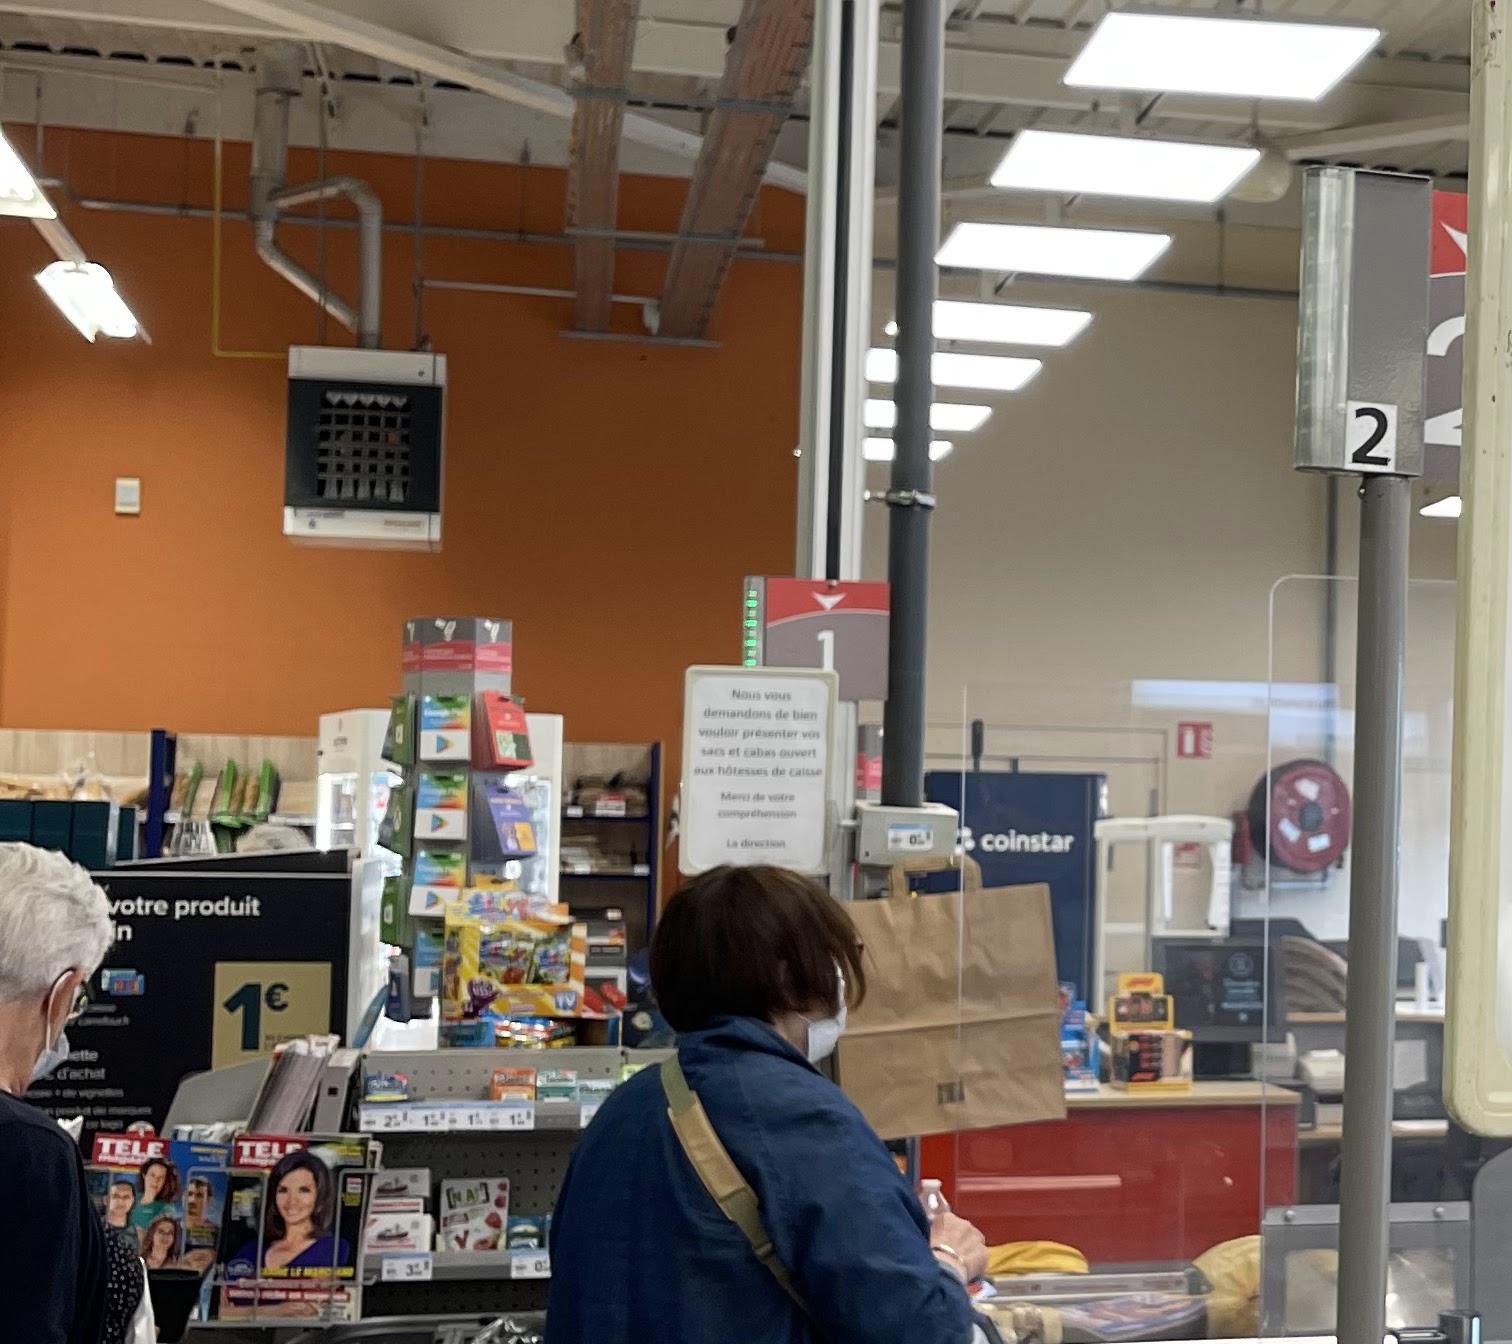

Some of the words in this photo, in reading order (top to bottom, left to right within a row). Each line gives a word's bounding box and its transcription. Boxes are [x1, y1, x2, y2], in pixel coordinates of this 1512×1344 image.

[1351, 406, 1393, 467] 2
[817, 629, 835, 672] 1
[732, 689, 761, 701] Nous
[764, 691, 792, 701] vous
[775, 709, 789, 720] de
[980, 829, 1075, 853] coinstar
[109, 896, 168, 916] votre
[174, 895, 262, 920] produit
[97, 1137, 164, 1157] TELE
